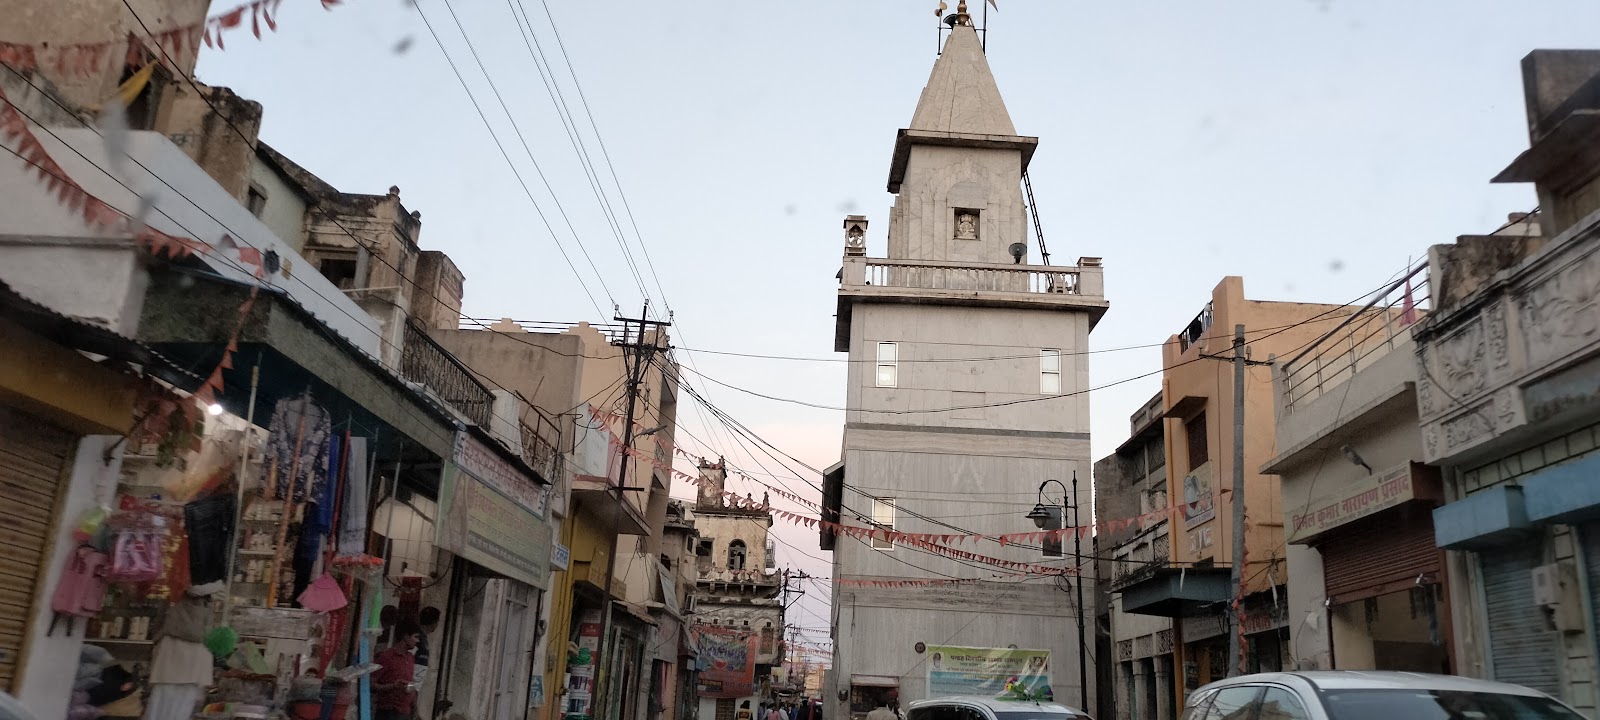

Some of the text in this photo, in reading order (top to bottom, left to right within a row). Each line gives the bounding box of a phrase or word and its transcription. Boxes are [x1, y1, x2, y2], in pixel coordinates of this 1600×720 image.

[1317, 502, 1340, 529] कुमार
[1341, 487, 1379, 513] नारायण
[1381, 474, 1410, 501] प्रसाद
